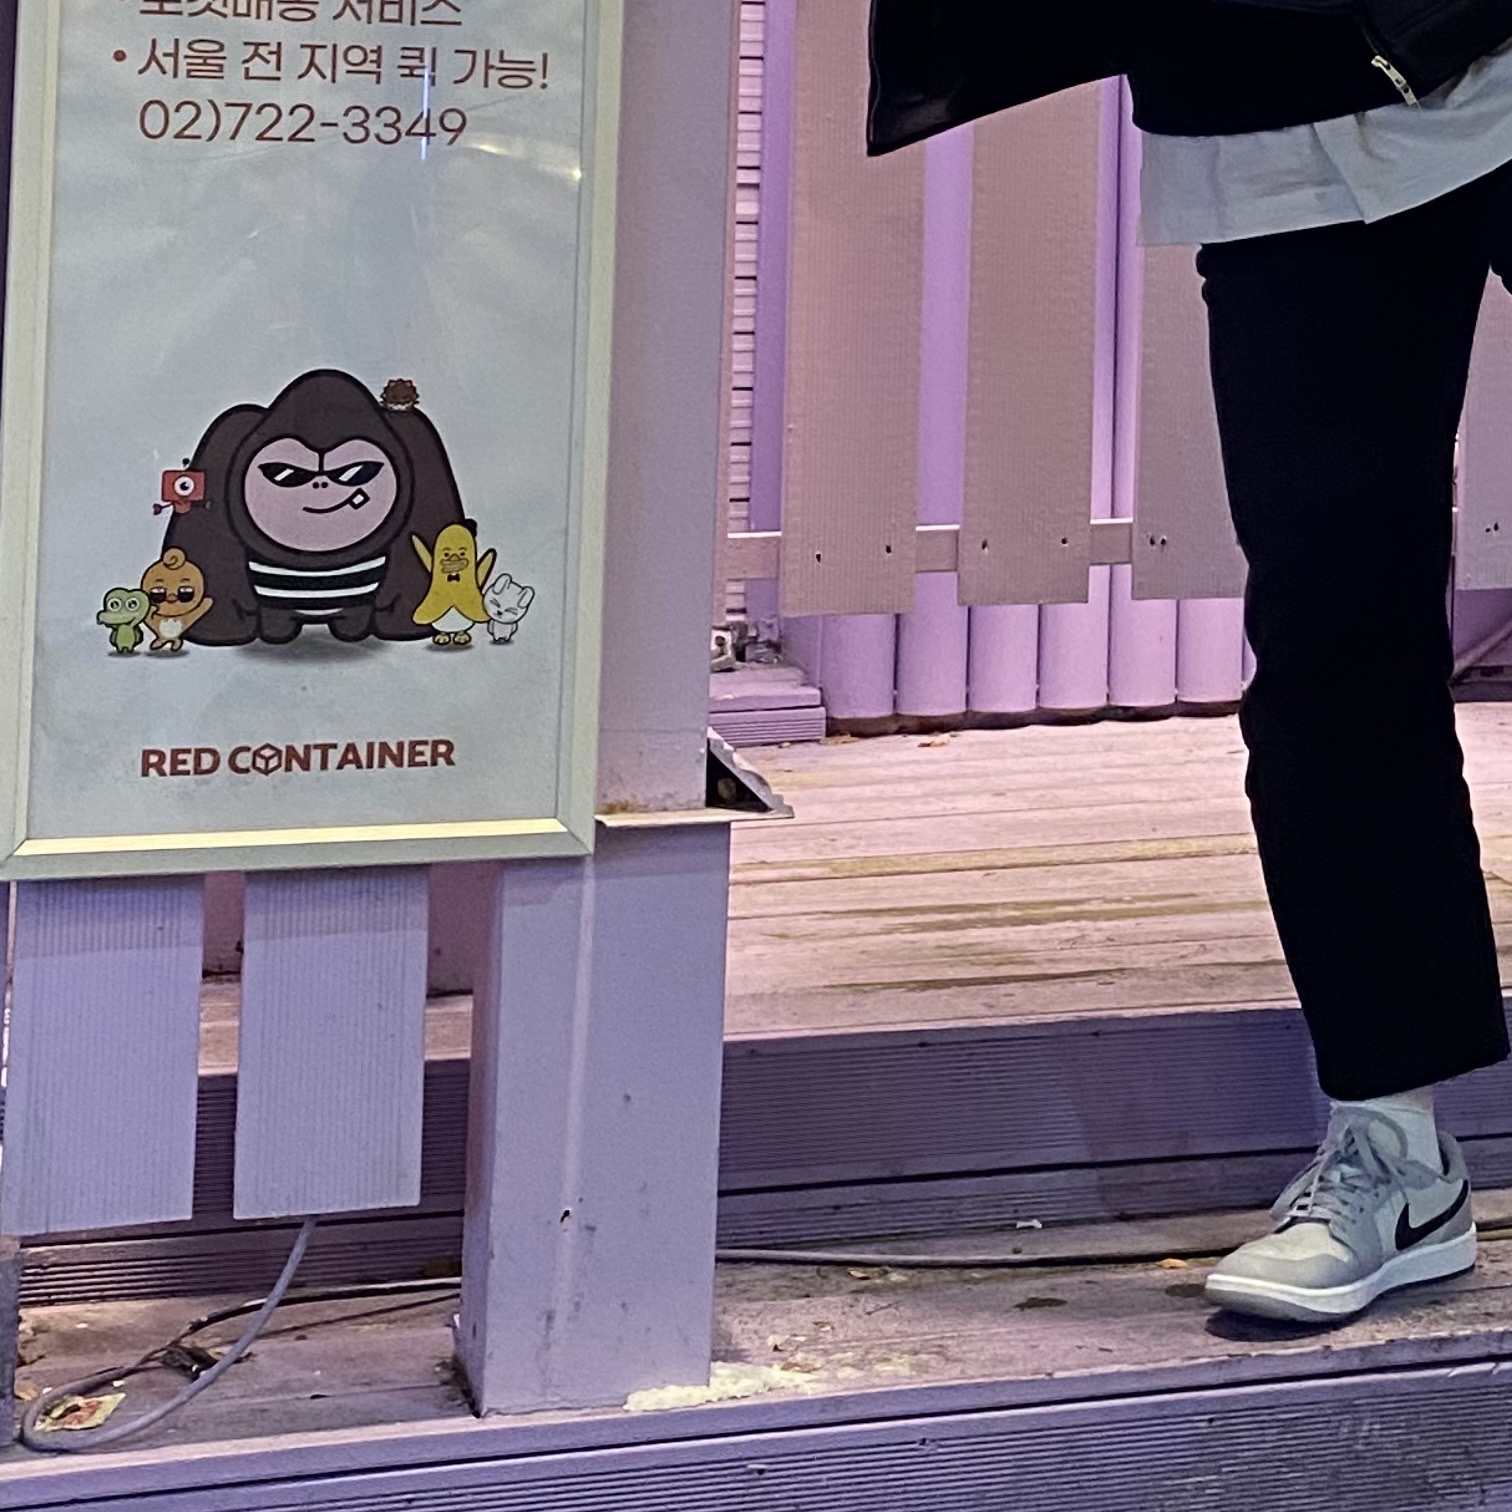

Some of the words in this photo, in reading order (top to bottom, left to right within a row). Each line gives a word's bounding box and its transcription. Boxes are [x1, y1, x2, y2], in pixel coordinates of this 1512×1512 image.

[137, 37, 227, 80] 서울
[240, 40, 283, 82] 전
[297, 43, 384, 85] 지역
[397, 46, 437, 87] 퀵
[452, 48, 550, 90] 가능!
[137, 97, 468, 147] 02)722-3349
[140, 745, 220, 778] RED
[227, 738, 457, 776] CONTAINER
